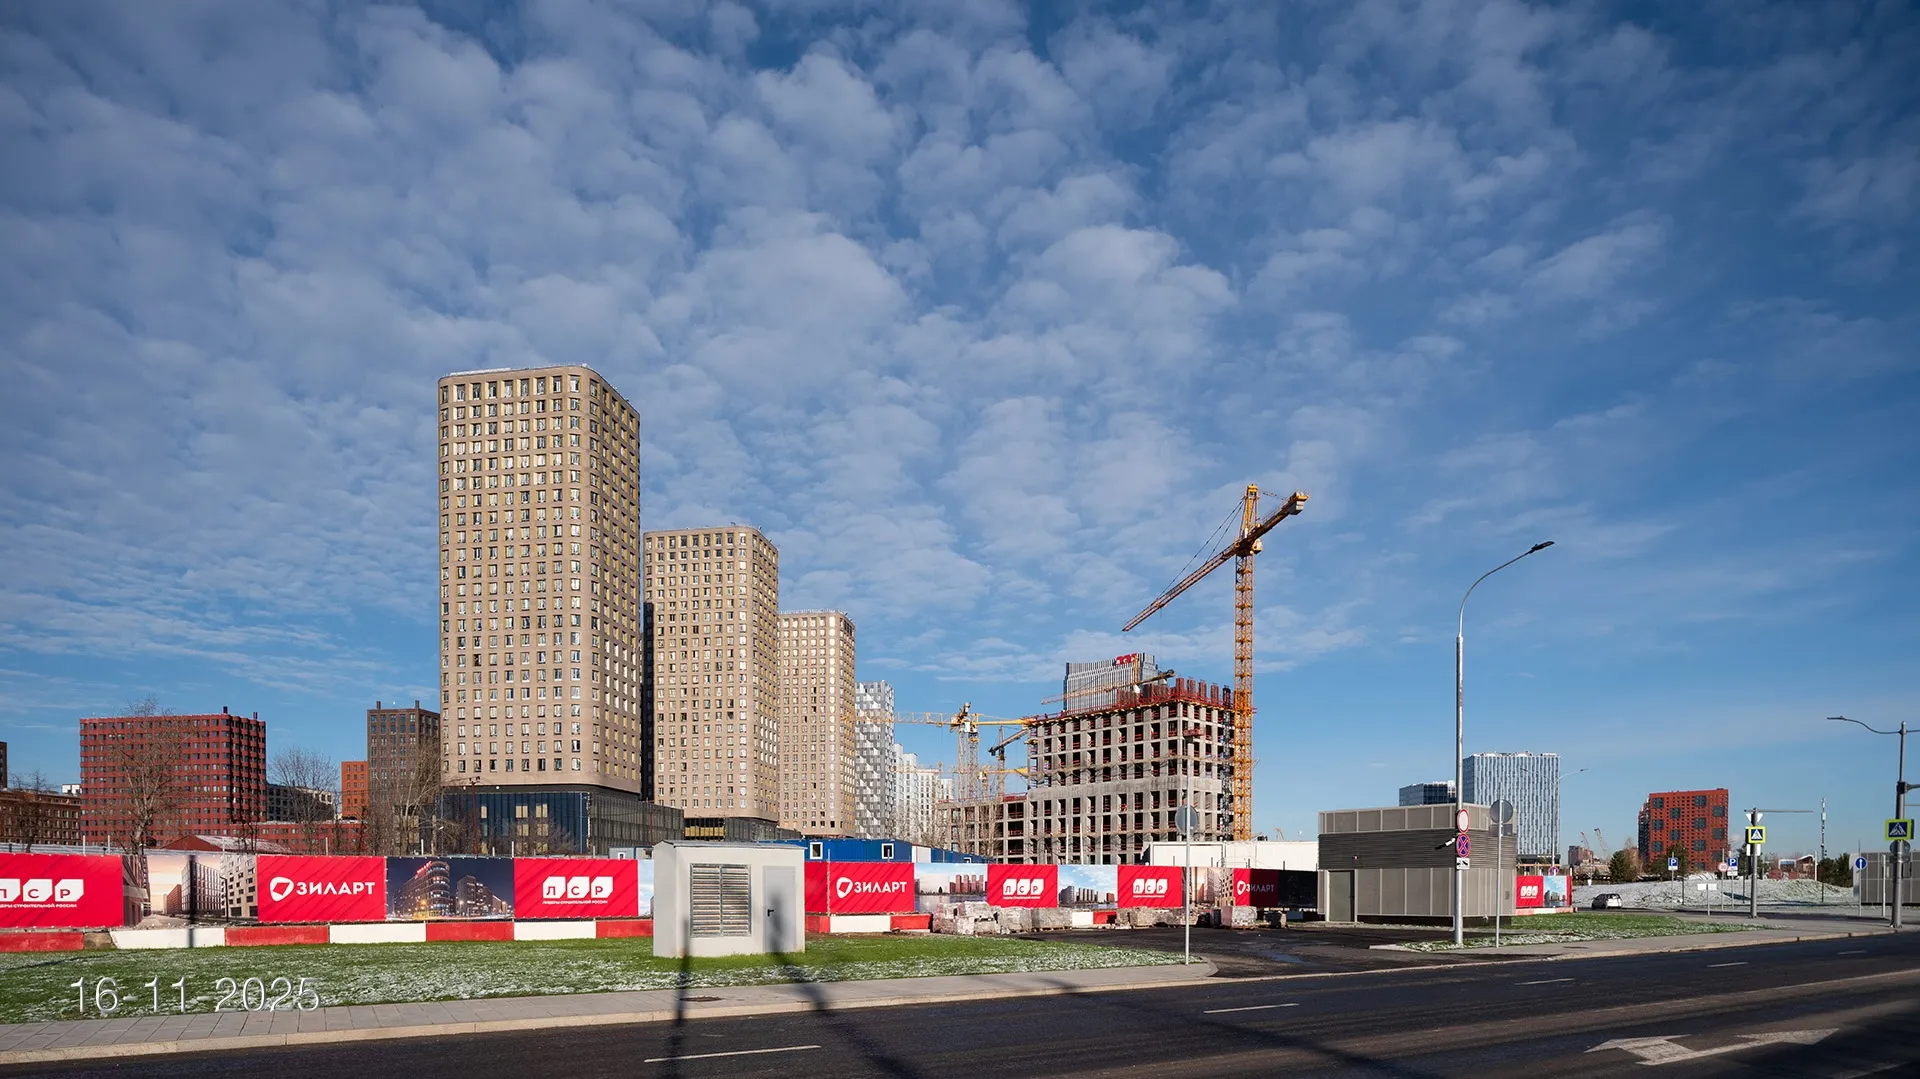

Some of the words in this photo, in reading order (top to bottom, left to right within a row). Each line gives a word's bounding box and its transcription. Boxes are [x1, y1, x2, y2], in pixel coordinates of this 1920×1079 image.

[296, 881, 376, 896] ЗИЛАРТ
[853, 881, 908, 894] ЗИЛАРТ
[1245, 883, 1275, 893] ЗИЛАРТ
